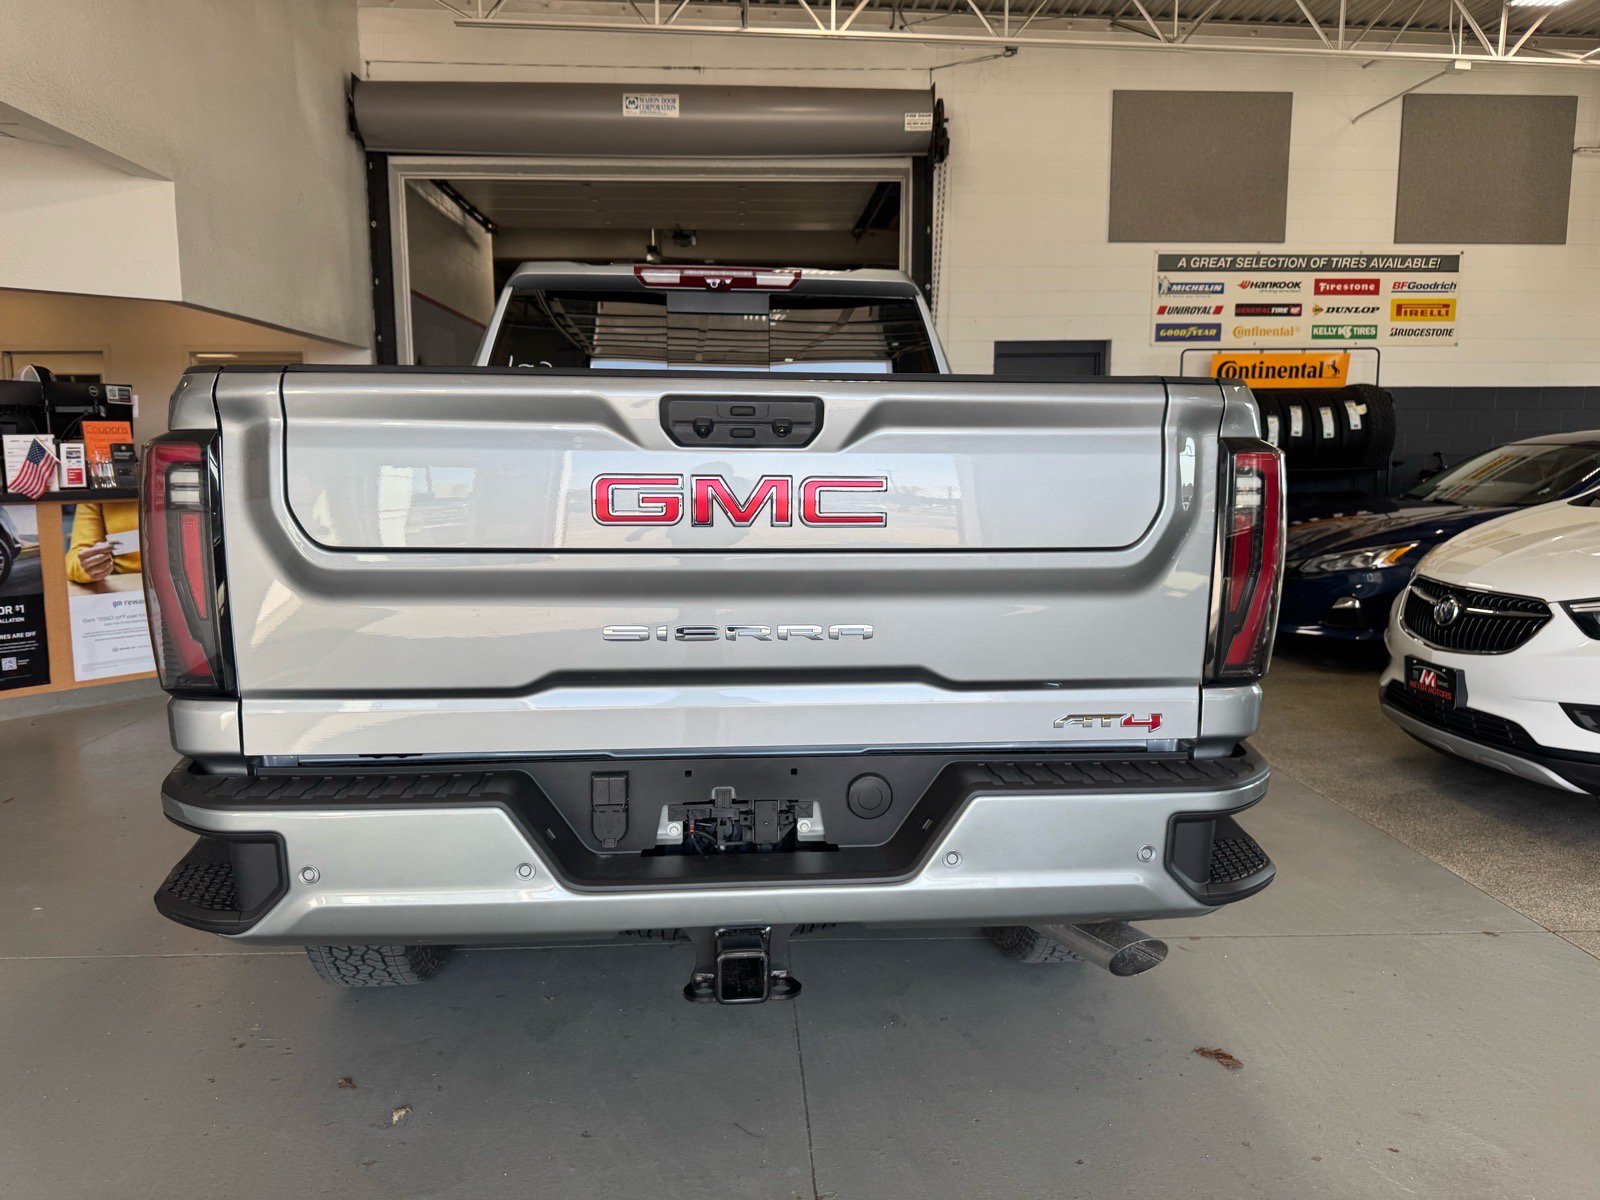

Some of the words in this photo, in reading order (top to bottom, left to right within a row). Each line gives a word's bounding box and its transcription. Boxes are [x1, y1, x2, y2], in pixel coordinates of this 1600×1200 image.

[1177, 257, 1187, 268] A
[1190, 257, 1233, 268] GREAT
[1235, 257, 1308, 268] SELECTION
[1310, 257, 1328, 268] OF
[1331, 257, 1367, 269] TIRES
[1369, 257, 1441, 269] AVAILABLE!
[1171, 284, 1223, 292] MICHELIN
[1319, 282, 1376, 292] Firestone
[1392, 281, 1457, 291] BFGoodrich
[1167, 305, 1212, 315] UNIROYAL
[1270, 306, 1289, 314] TIRE
[1325, 306, 1380, 314] DUNLOP
[1396, 303, 1450, 317] PIRELLI
[1160, 327, 1217, 337] GOODYEAR
[1232, 326, 1294, 339] Continental
[1313, 326, 1337, 336] KELLY
[1353, 326, 1377, 336] TIRES
[1390, 327, 1455, 338] BRIDGESTONE
[1216, 360, 1324, 379] Continental
[86, 425, 129, 435] Coupons
[590, 472, 888, 528] GMC
[602, 624, 874, 642] SIERRA
[1428, 687, 1452, 701] MOTORS
[1053, 712, 1163, 733] AT4
